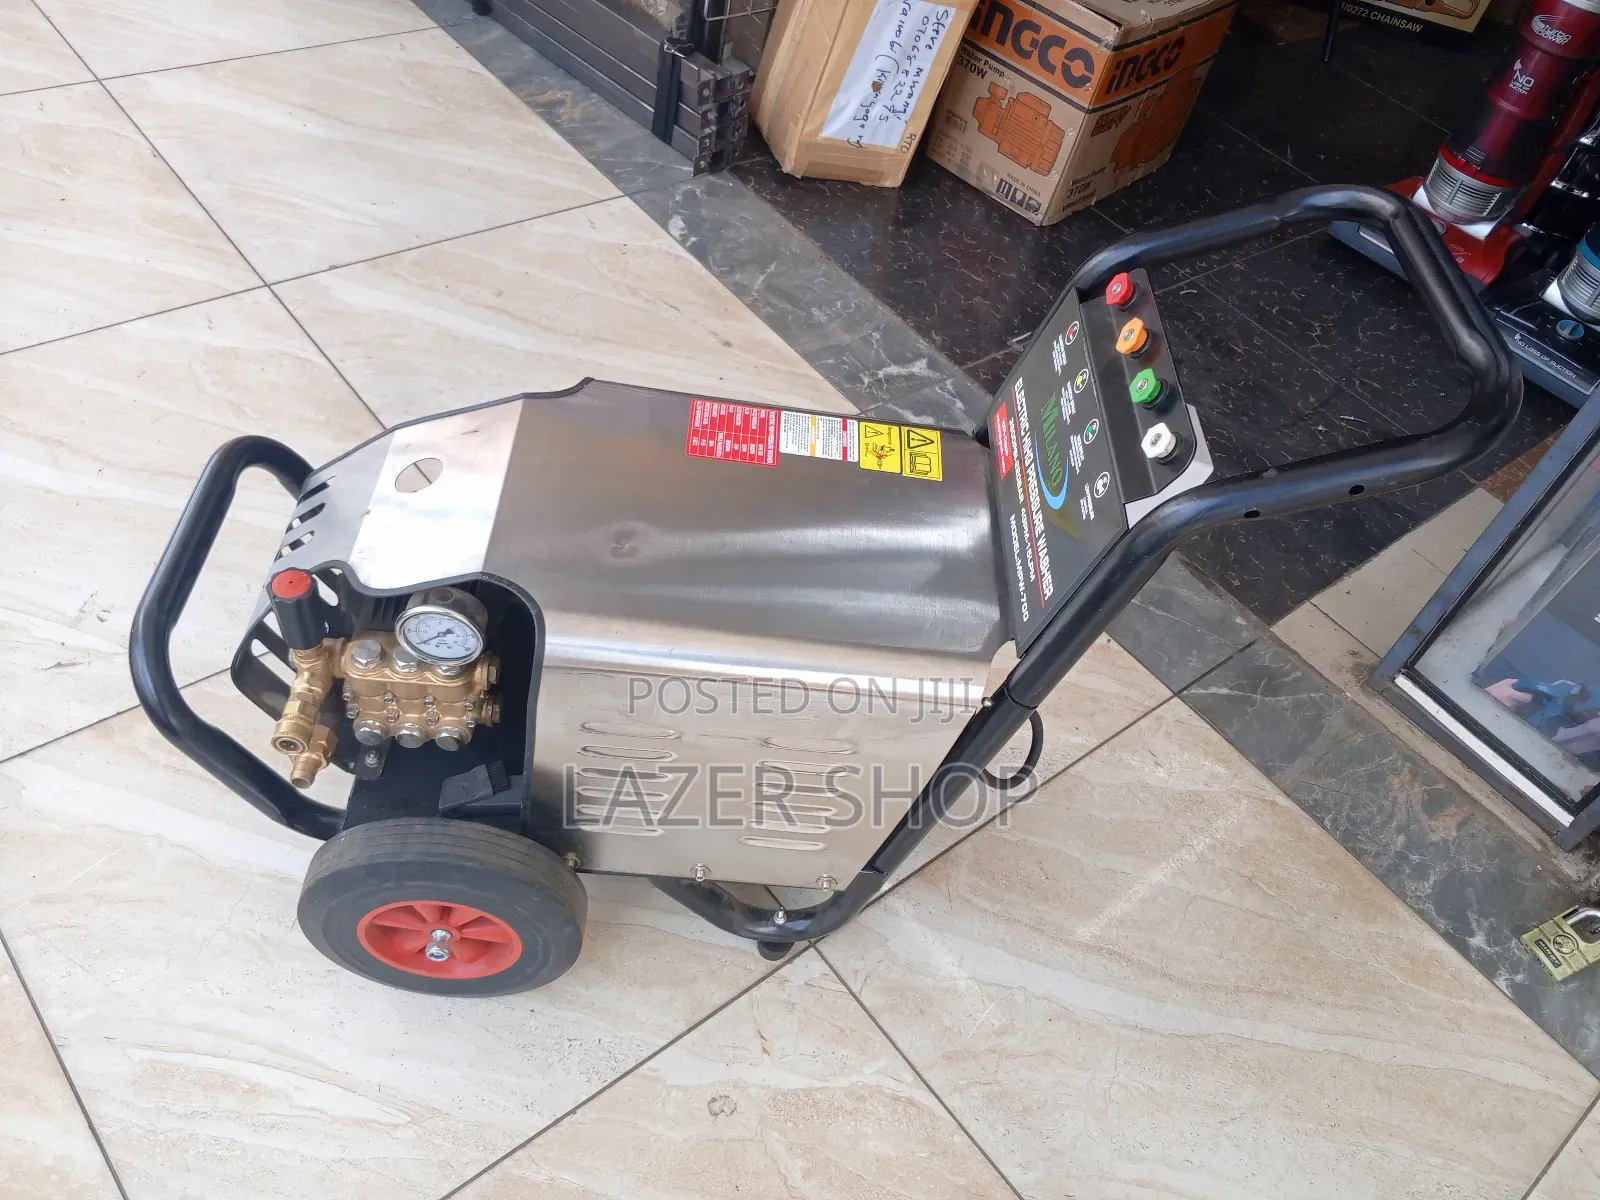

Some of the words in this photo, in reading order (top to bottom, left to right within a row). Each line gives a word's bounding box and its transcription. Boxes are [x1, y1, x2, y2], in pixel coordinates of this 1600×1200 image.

[1370, 11, 1424, 33] CHAINSAW
[957, 56, 988, 79] 370W
[983, 60, 1005, 77] Pump
[1513, 69, 1535, 88] NO
[1007, 172, 1020, 185] MADE
[1019, 180, 1026, 188] IN
[1025, 184, 1041, 198] CHINA
[1525, 343, 1541, 357] LOSS
[1550, 360, 1577, 378] SUCTION
[1014, 377, 1029, 436] ELECTRIC
[1026, 462, 1045, 538] PRESSURE
[1037, 533, 1054, 601] WASHER
